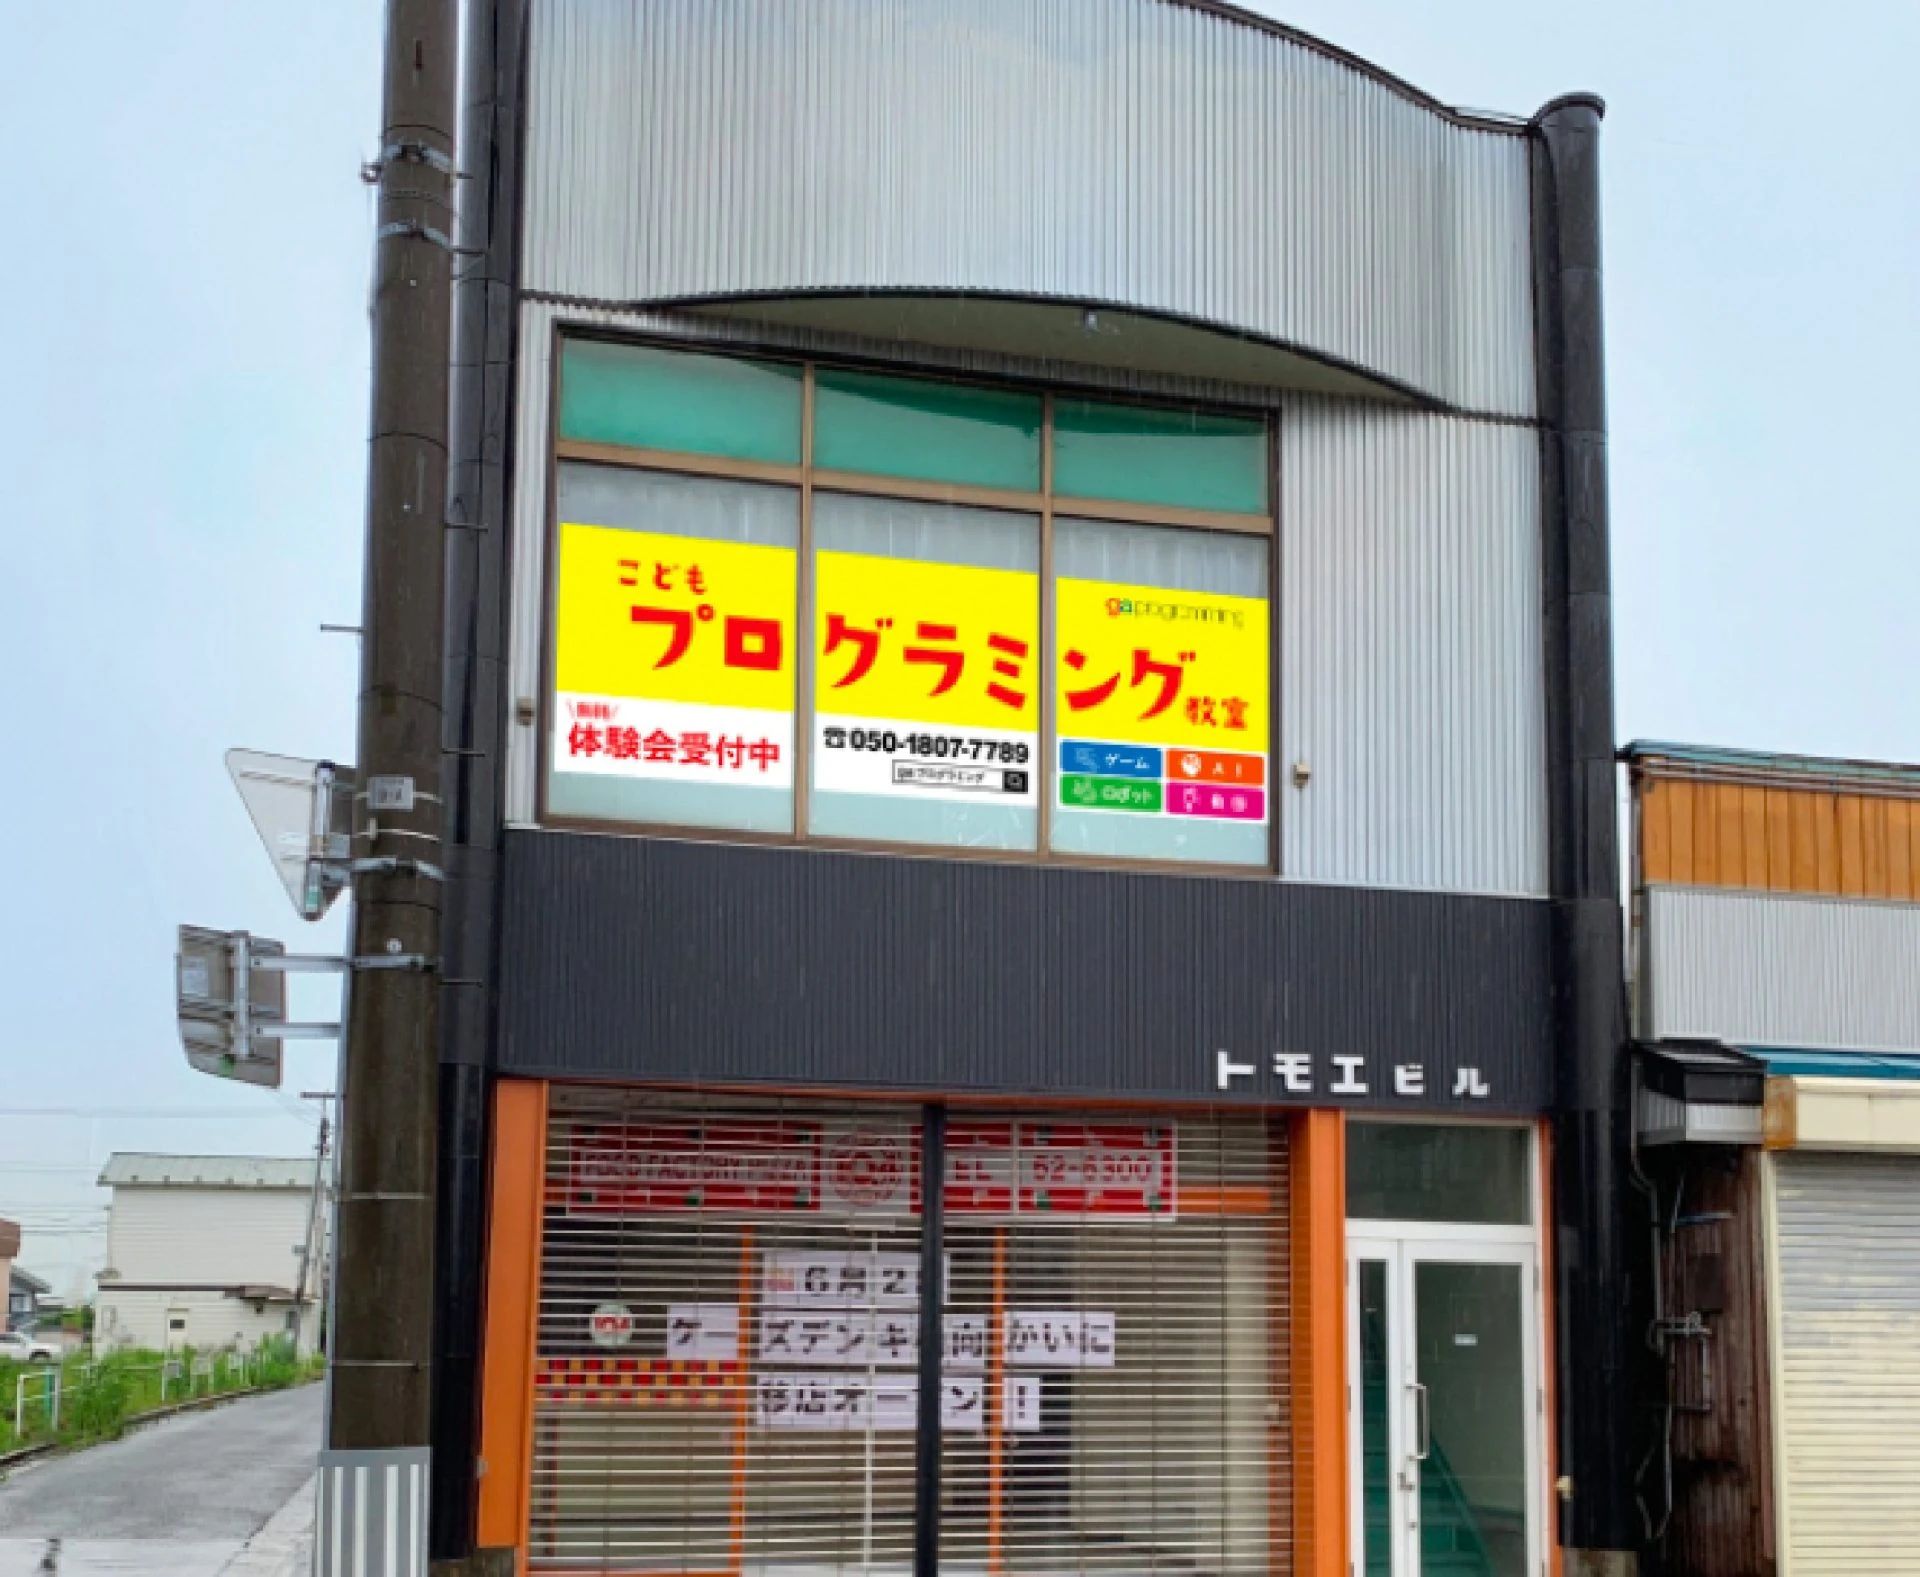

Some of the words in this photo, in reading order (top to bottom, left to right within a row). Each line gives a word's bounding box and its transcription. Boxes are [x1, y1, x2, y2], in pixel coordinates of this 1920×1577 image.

[618, 559, 707, 595] こども
[568, 721, 780, 772] 体験会受付中
[850, 728, 1029, 764] 050-1807-7789
[1216, 1050, 1490, 1097] トモエビル
